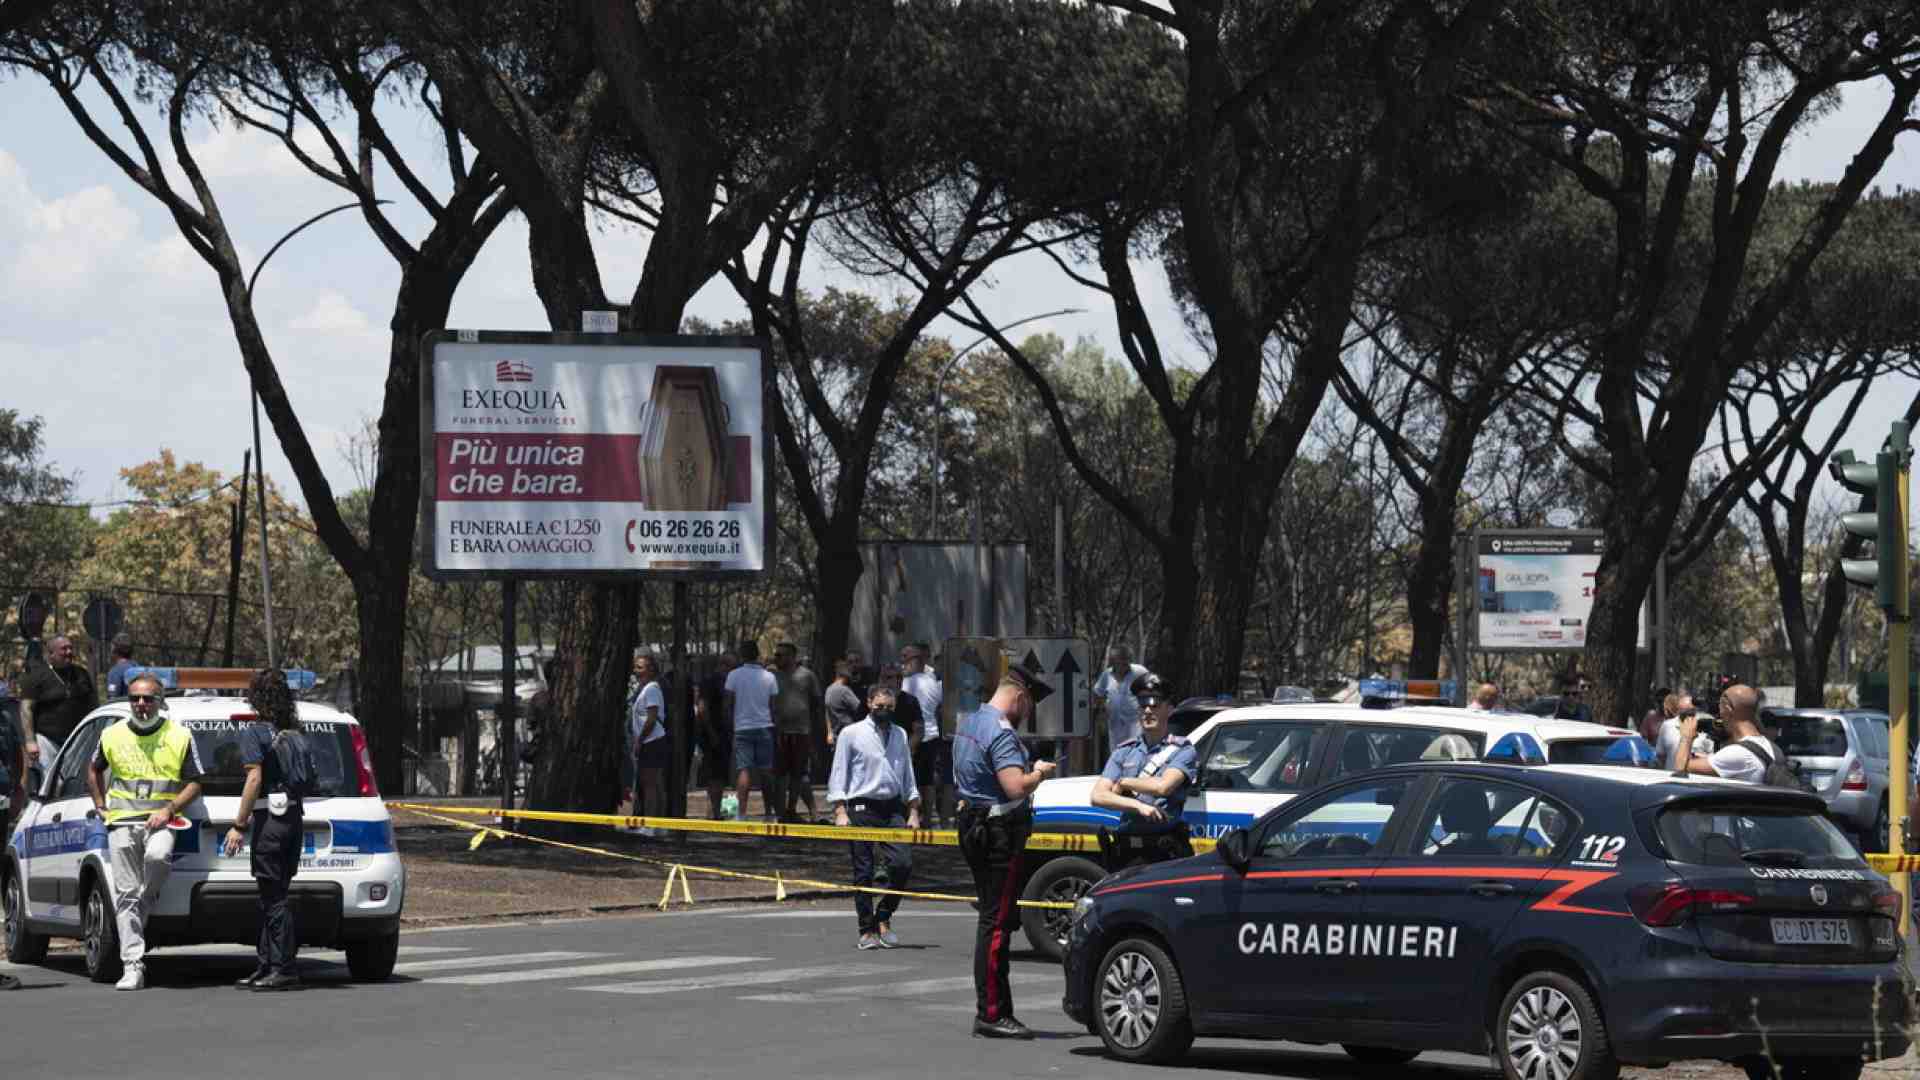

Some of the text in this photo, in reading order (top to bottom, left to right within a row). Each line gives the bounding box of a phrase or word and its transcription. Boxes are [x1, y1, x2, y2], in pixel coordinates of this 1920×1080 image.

[463, 389, 568, 413] EXEQUIA
[452, 416, 576, 425] FUNERAL SERVICES
[449, 438, 585, 466] Più unica
[449, 467, 584, 494] che bara.
[450, 519, 534, 536] FUNERALE
[640, 519, 741, 538] 06 26 26 26
[450, 538, 595, 554] E BARA OMAGGIO.
[640, 542, 740, 555] www.exequia.it
[184, 720, 236, 732] POLIZIA
[304, 721, 337, 734] ITALE
[1580, 834, 1626, 861] 112
[1238, 922, 1458, 958] CARABINIERI
[1823, 919, 1849, 942] 576
